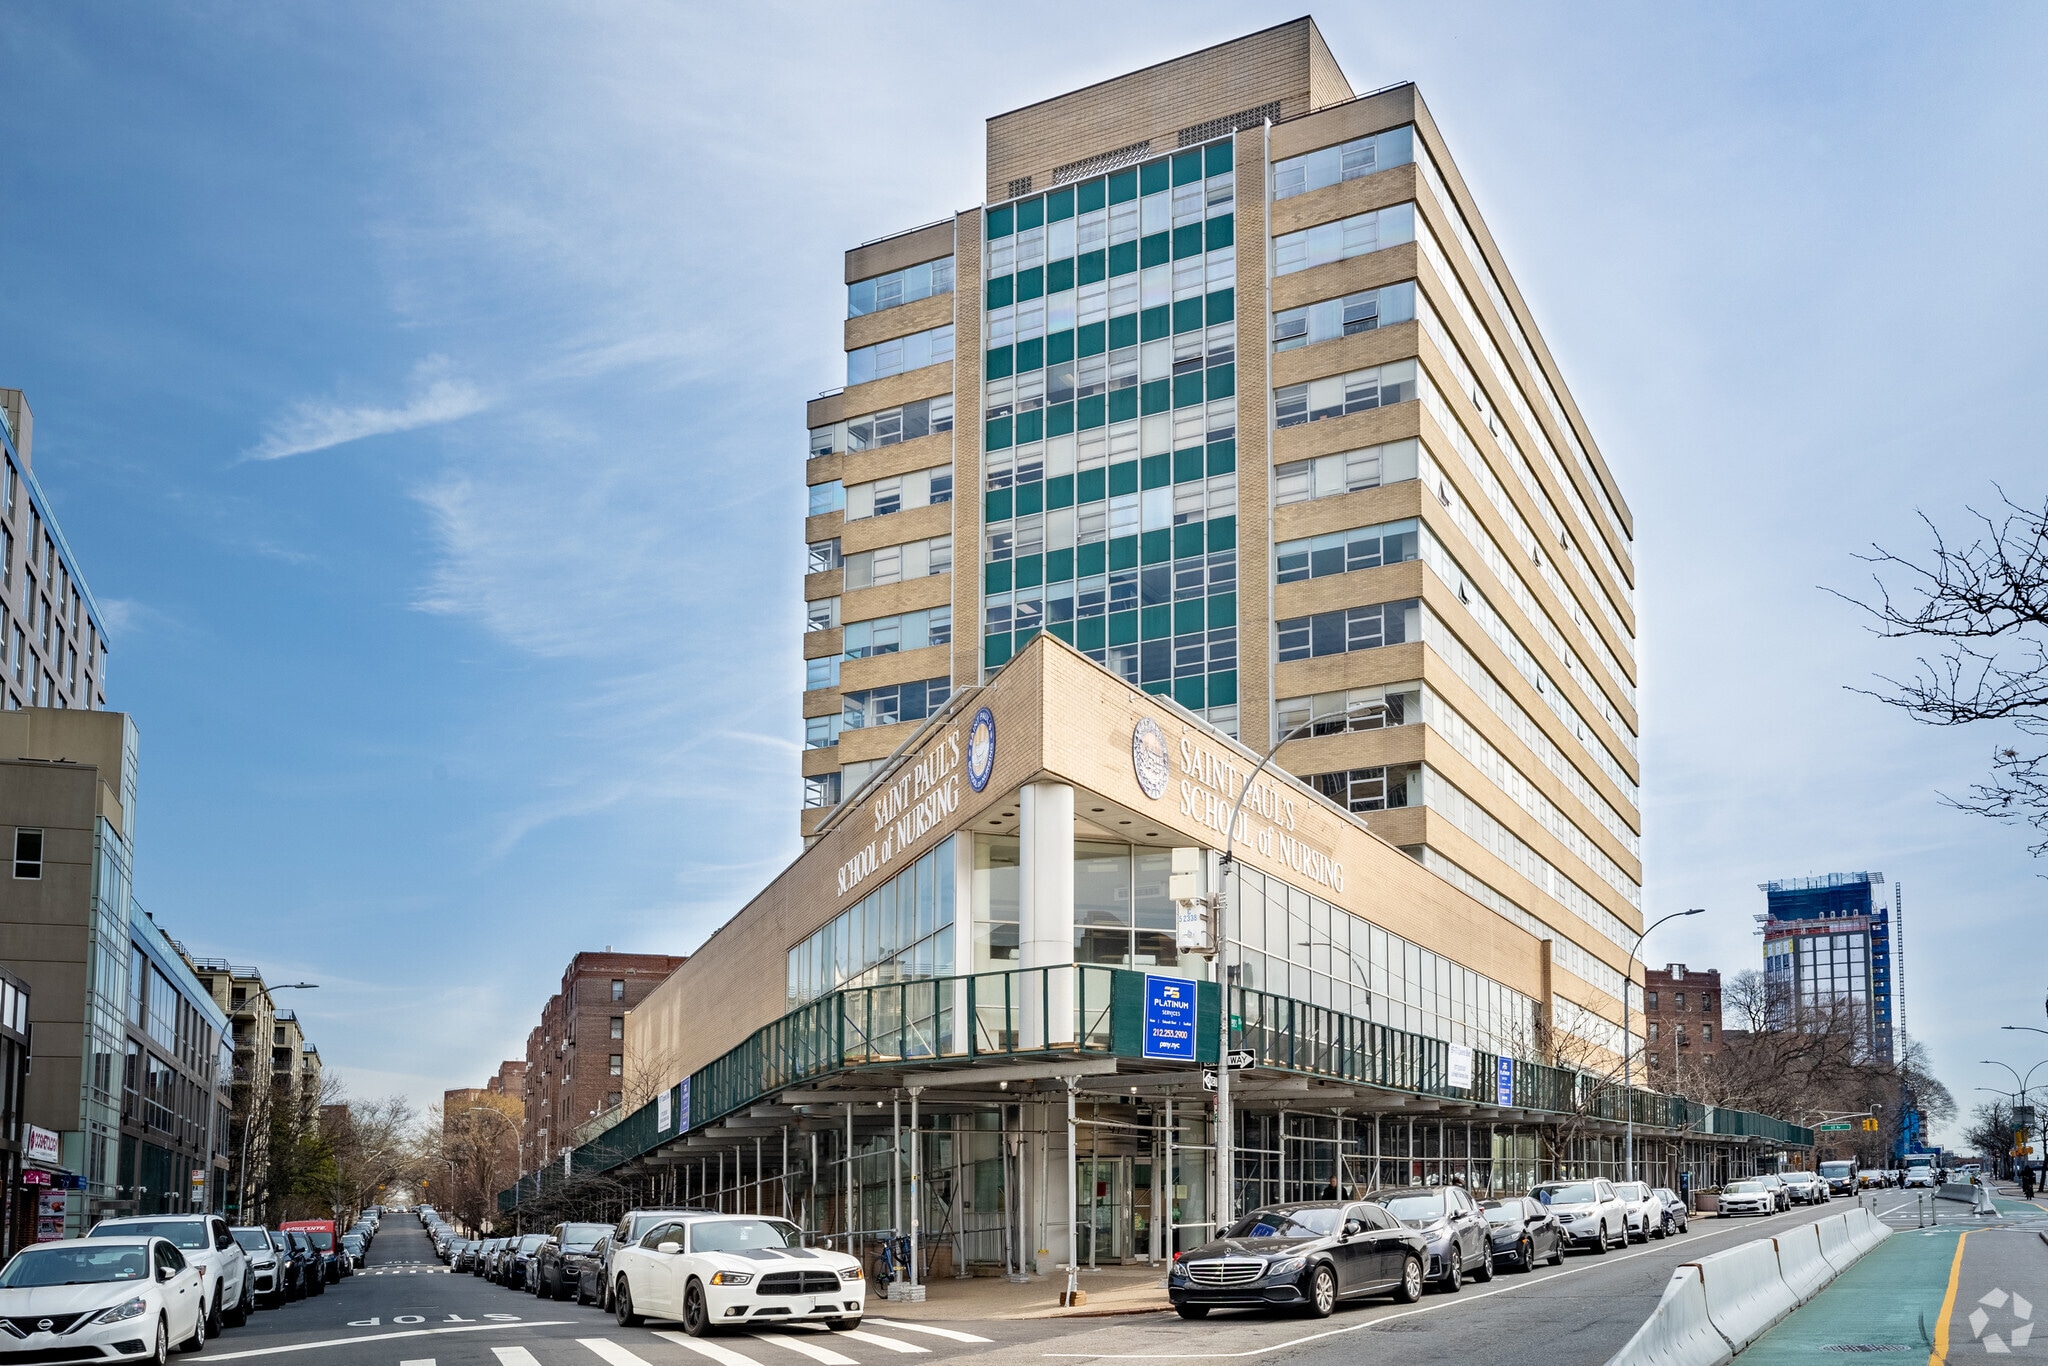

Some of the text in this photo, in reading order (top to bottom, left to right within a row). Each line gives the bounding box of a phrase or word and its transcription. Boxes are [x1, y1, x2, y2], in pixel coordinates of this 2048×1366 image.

[874, 729, 960, 833] SAINT PAUL'S
[1180, 738, 1237, 800] SAINT
[1242, 772, 1295, 832] PAUL'S
[837, 773, 960, 897] SCHOOL of NURSING
[1180, 779, 1344, 893] SCHOOL of NURSING
[1153, 998, 1189, 1009] PLATINUM
[1229, 1055, 1248, 1064] WAY
[346, 1313, 523, 1327] STOP
